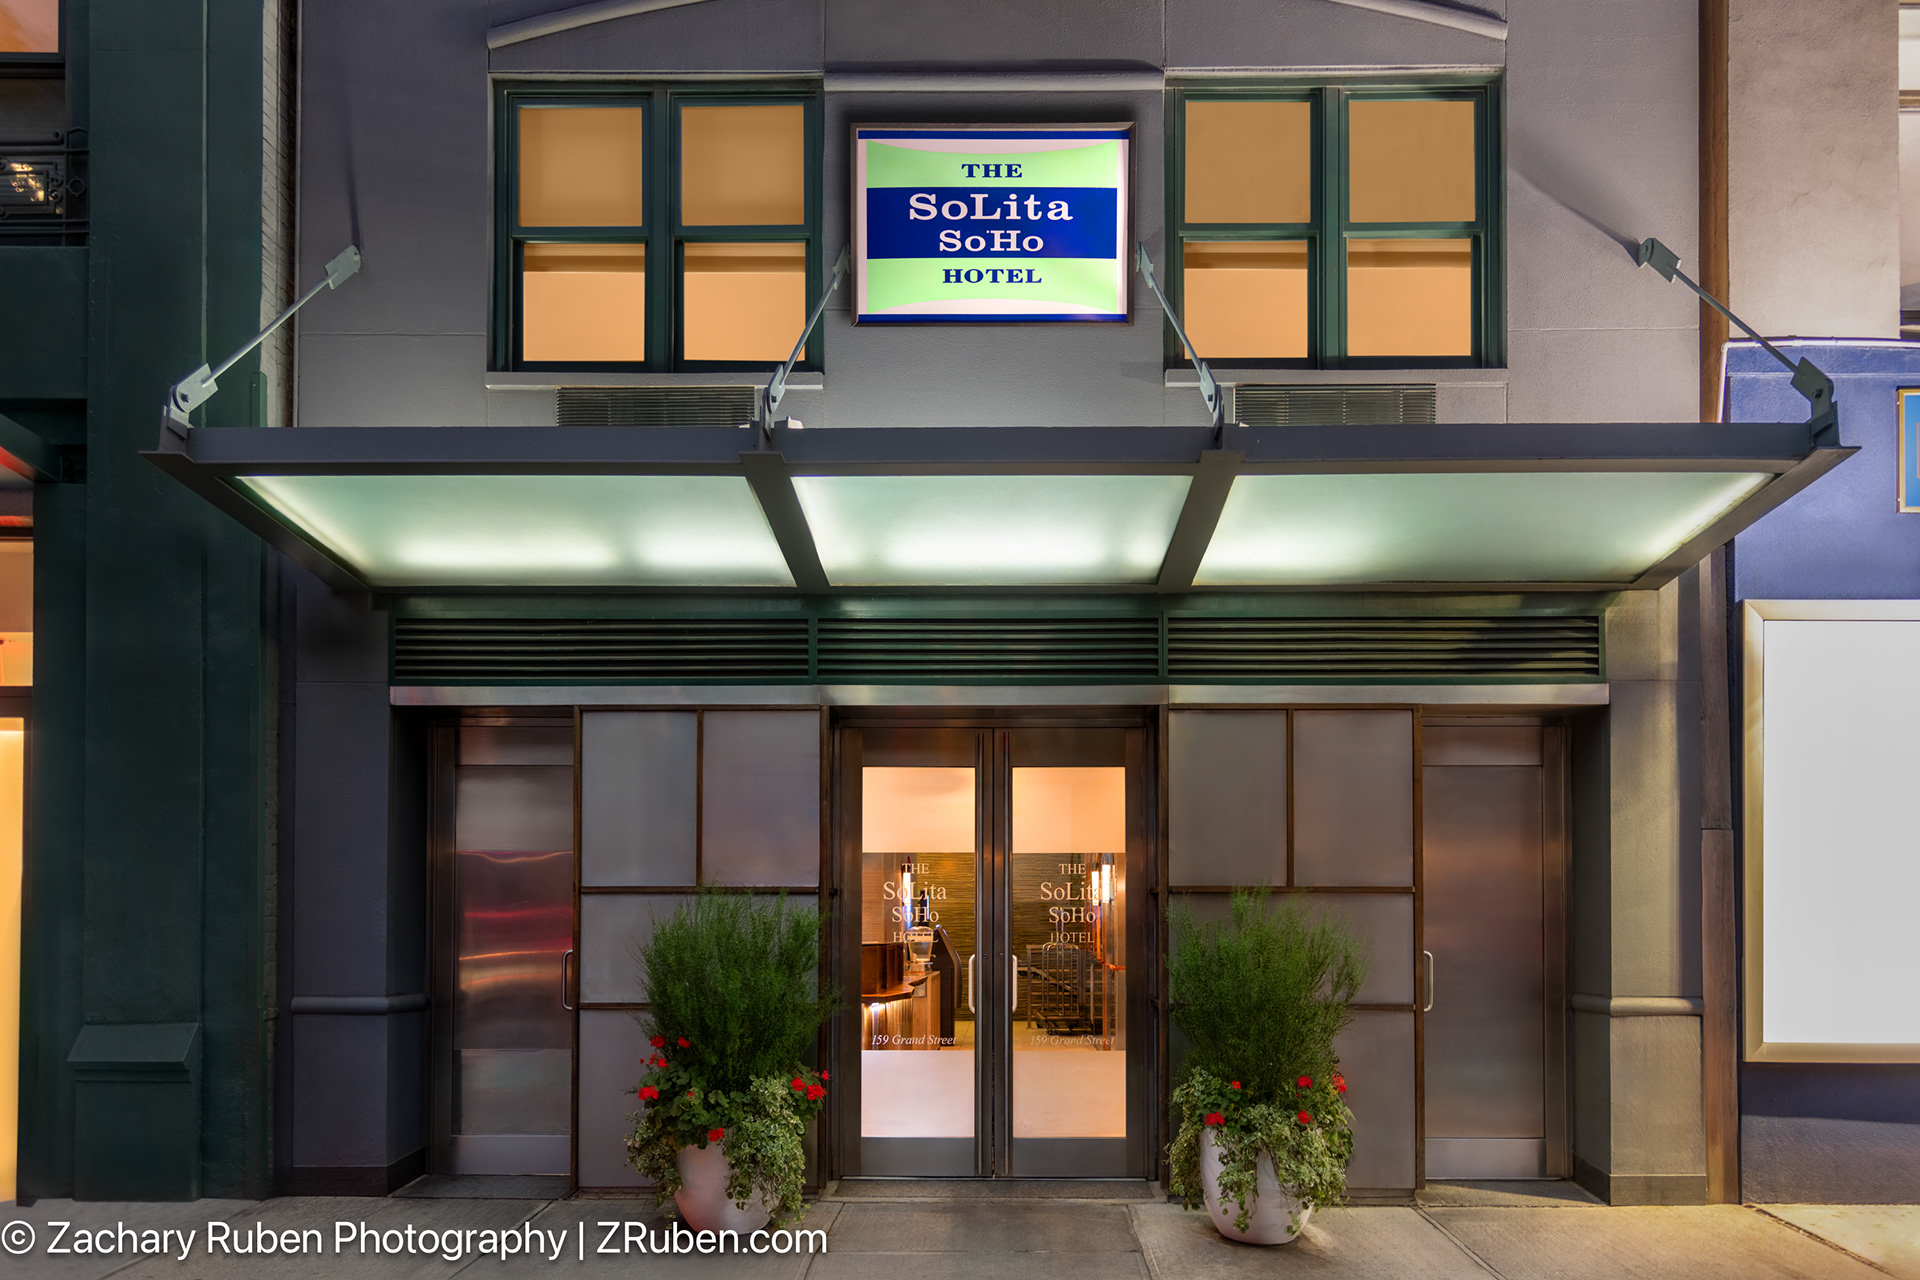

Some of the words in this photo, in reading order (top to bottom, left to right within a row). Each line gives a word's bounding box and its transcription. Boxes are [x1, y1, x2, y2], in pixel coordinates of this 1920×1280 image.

[961, 163, 1023, 178] THE
[909, 193, 1074, 221] SoLita
[939, 229, 1044, 252] SoHo
[942, 268, 1042, 284] HOTEL
[902, 863, 930, 874] THE
[1059, 863, 1087, 875] THE
[883, 881, 948, 901] SoLita
[1040, 881, 1103, 901] SoLita
[892, 906, 940, 923] SoHo
[1049, 906, 1096, 923] SoHo
[871, 1034, 890, 1046] 159
[892, 1034, 926, 1046] Grand
[927, 1034, 957, 1046] Street
[1030, 1034, 1048, 1046] 159
[1050, 1034, 1085, 1046] Grand
[1085, 1034, 1115, 1046] Street
